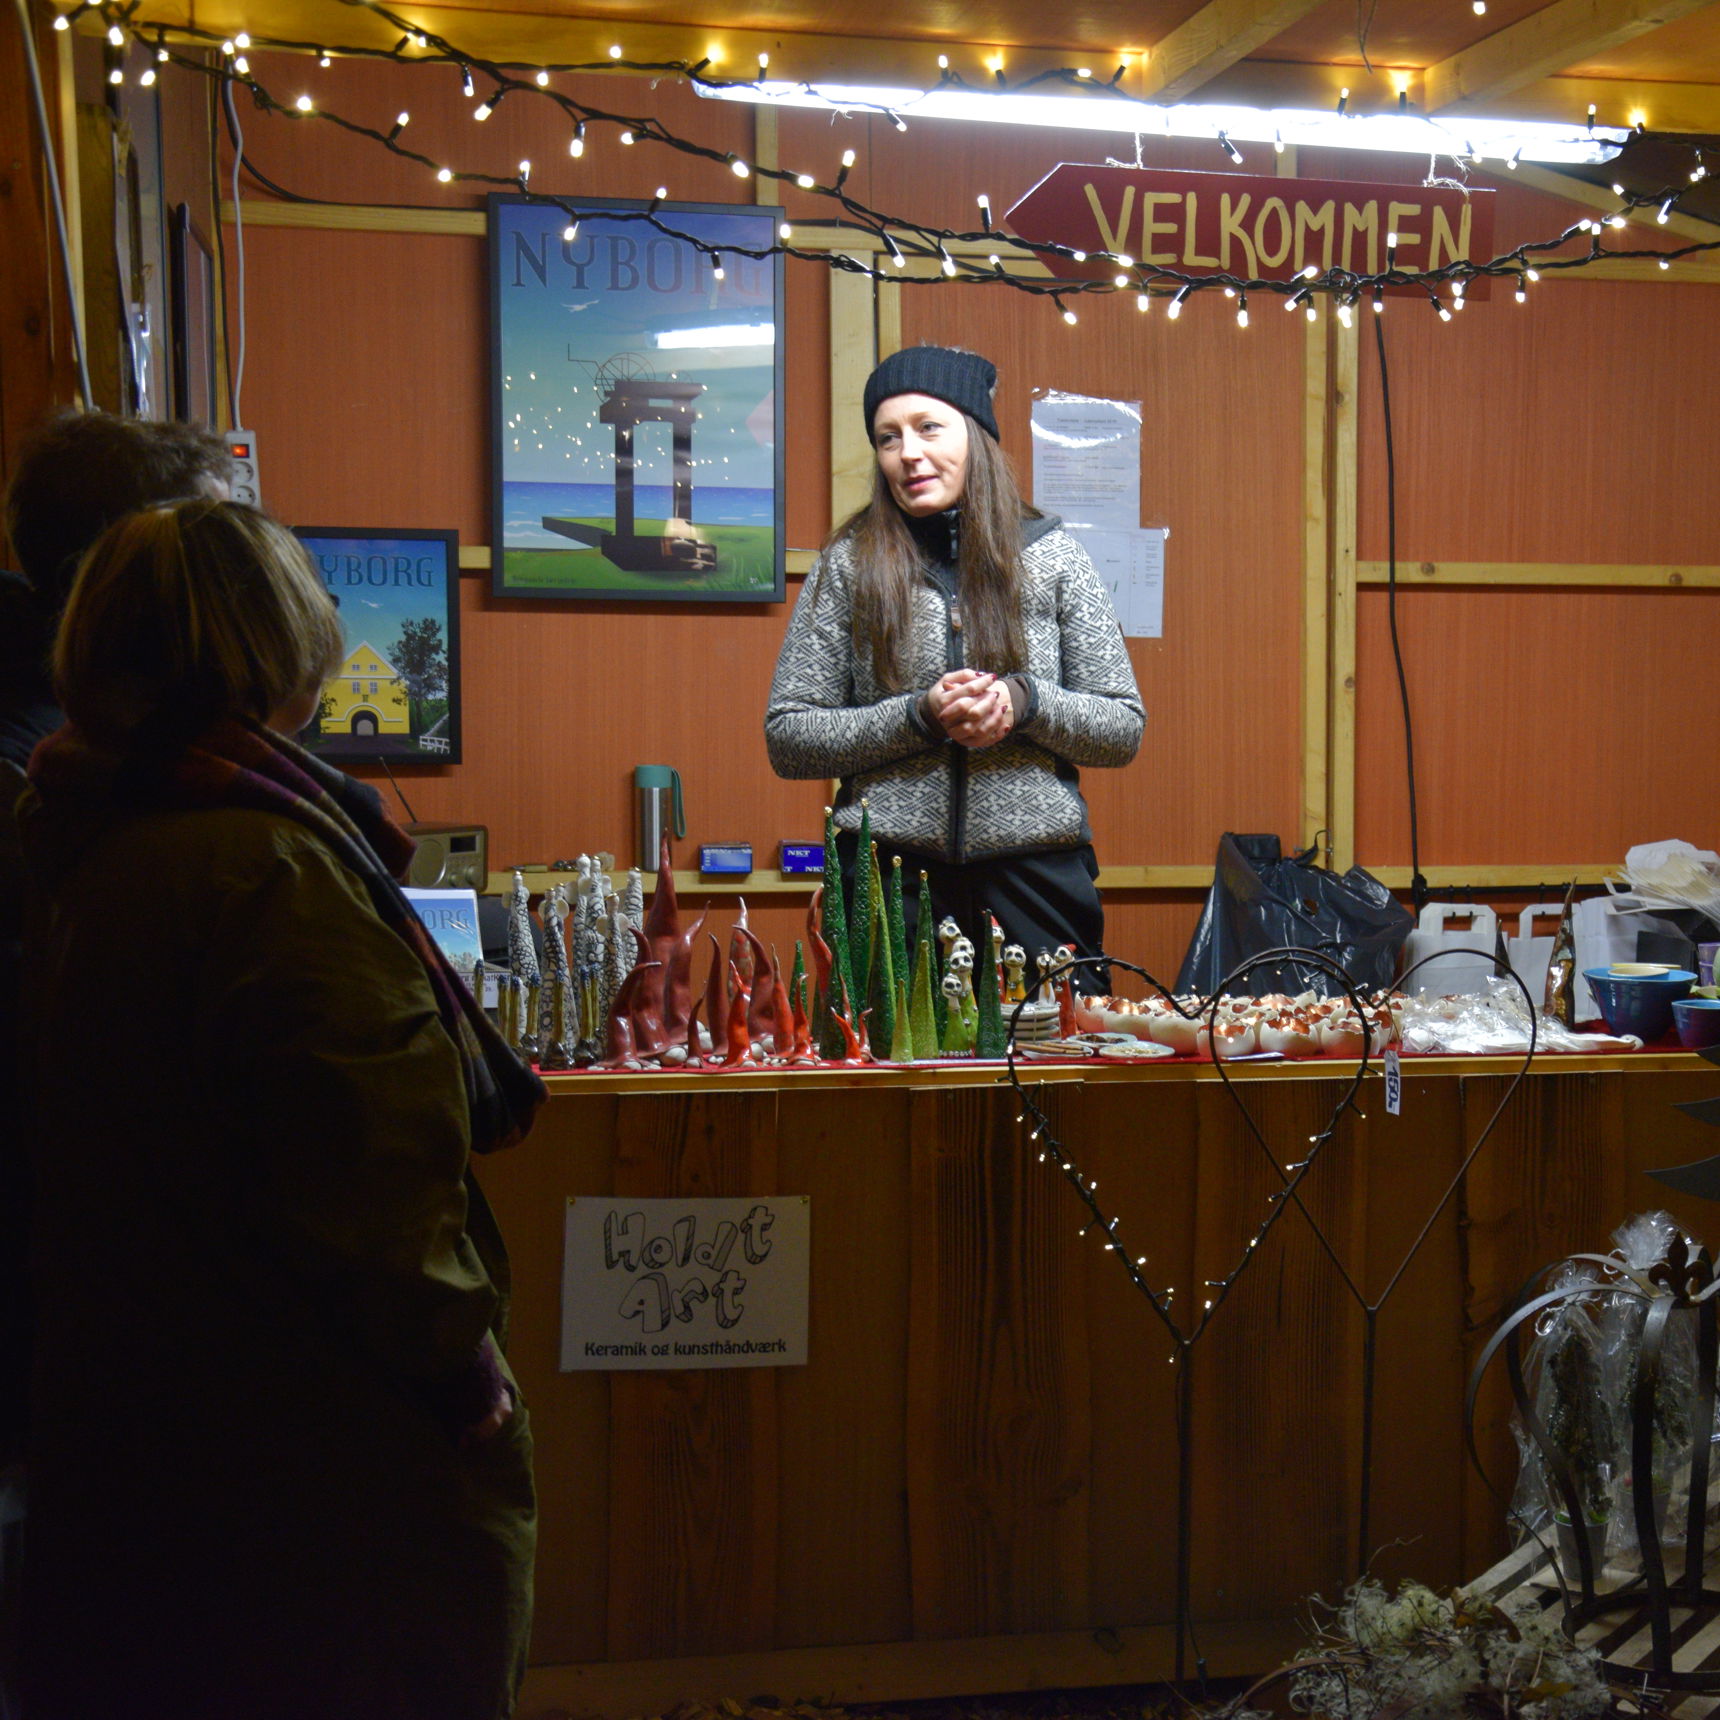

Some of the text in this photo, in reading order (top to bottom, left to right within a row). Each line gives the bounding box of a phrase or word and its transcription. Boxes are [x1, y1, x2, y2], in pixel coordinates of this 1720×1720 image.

[1084, 183, 1472, 280] VELKOMMEN
[511, 230, 763, 298] NYBORG
[317, 554, 434, 587] YBORG
[421, 909, 470, 930] ORG
[604, 1205, 775, 1272] Holdt
[618, 1270, 747, 1333] Art
[584, 1338, 787, 1356] Keramik og kunsthåndværk
